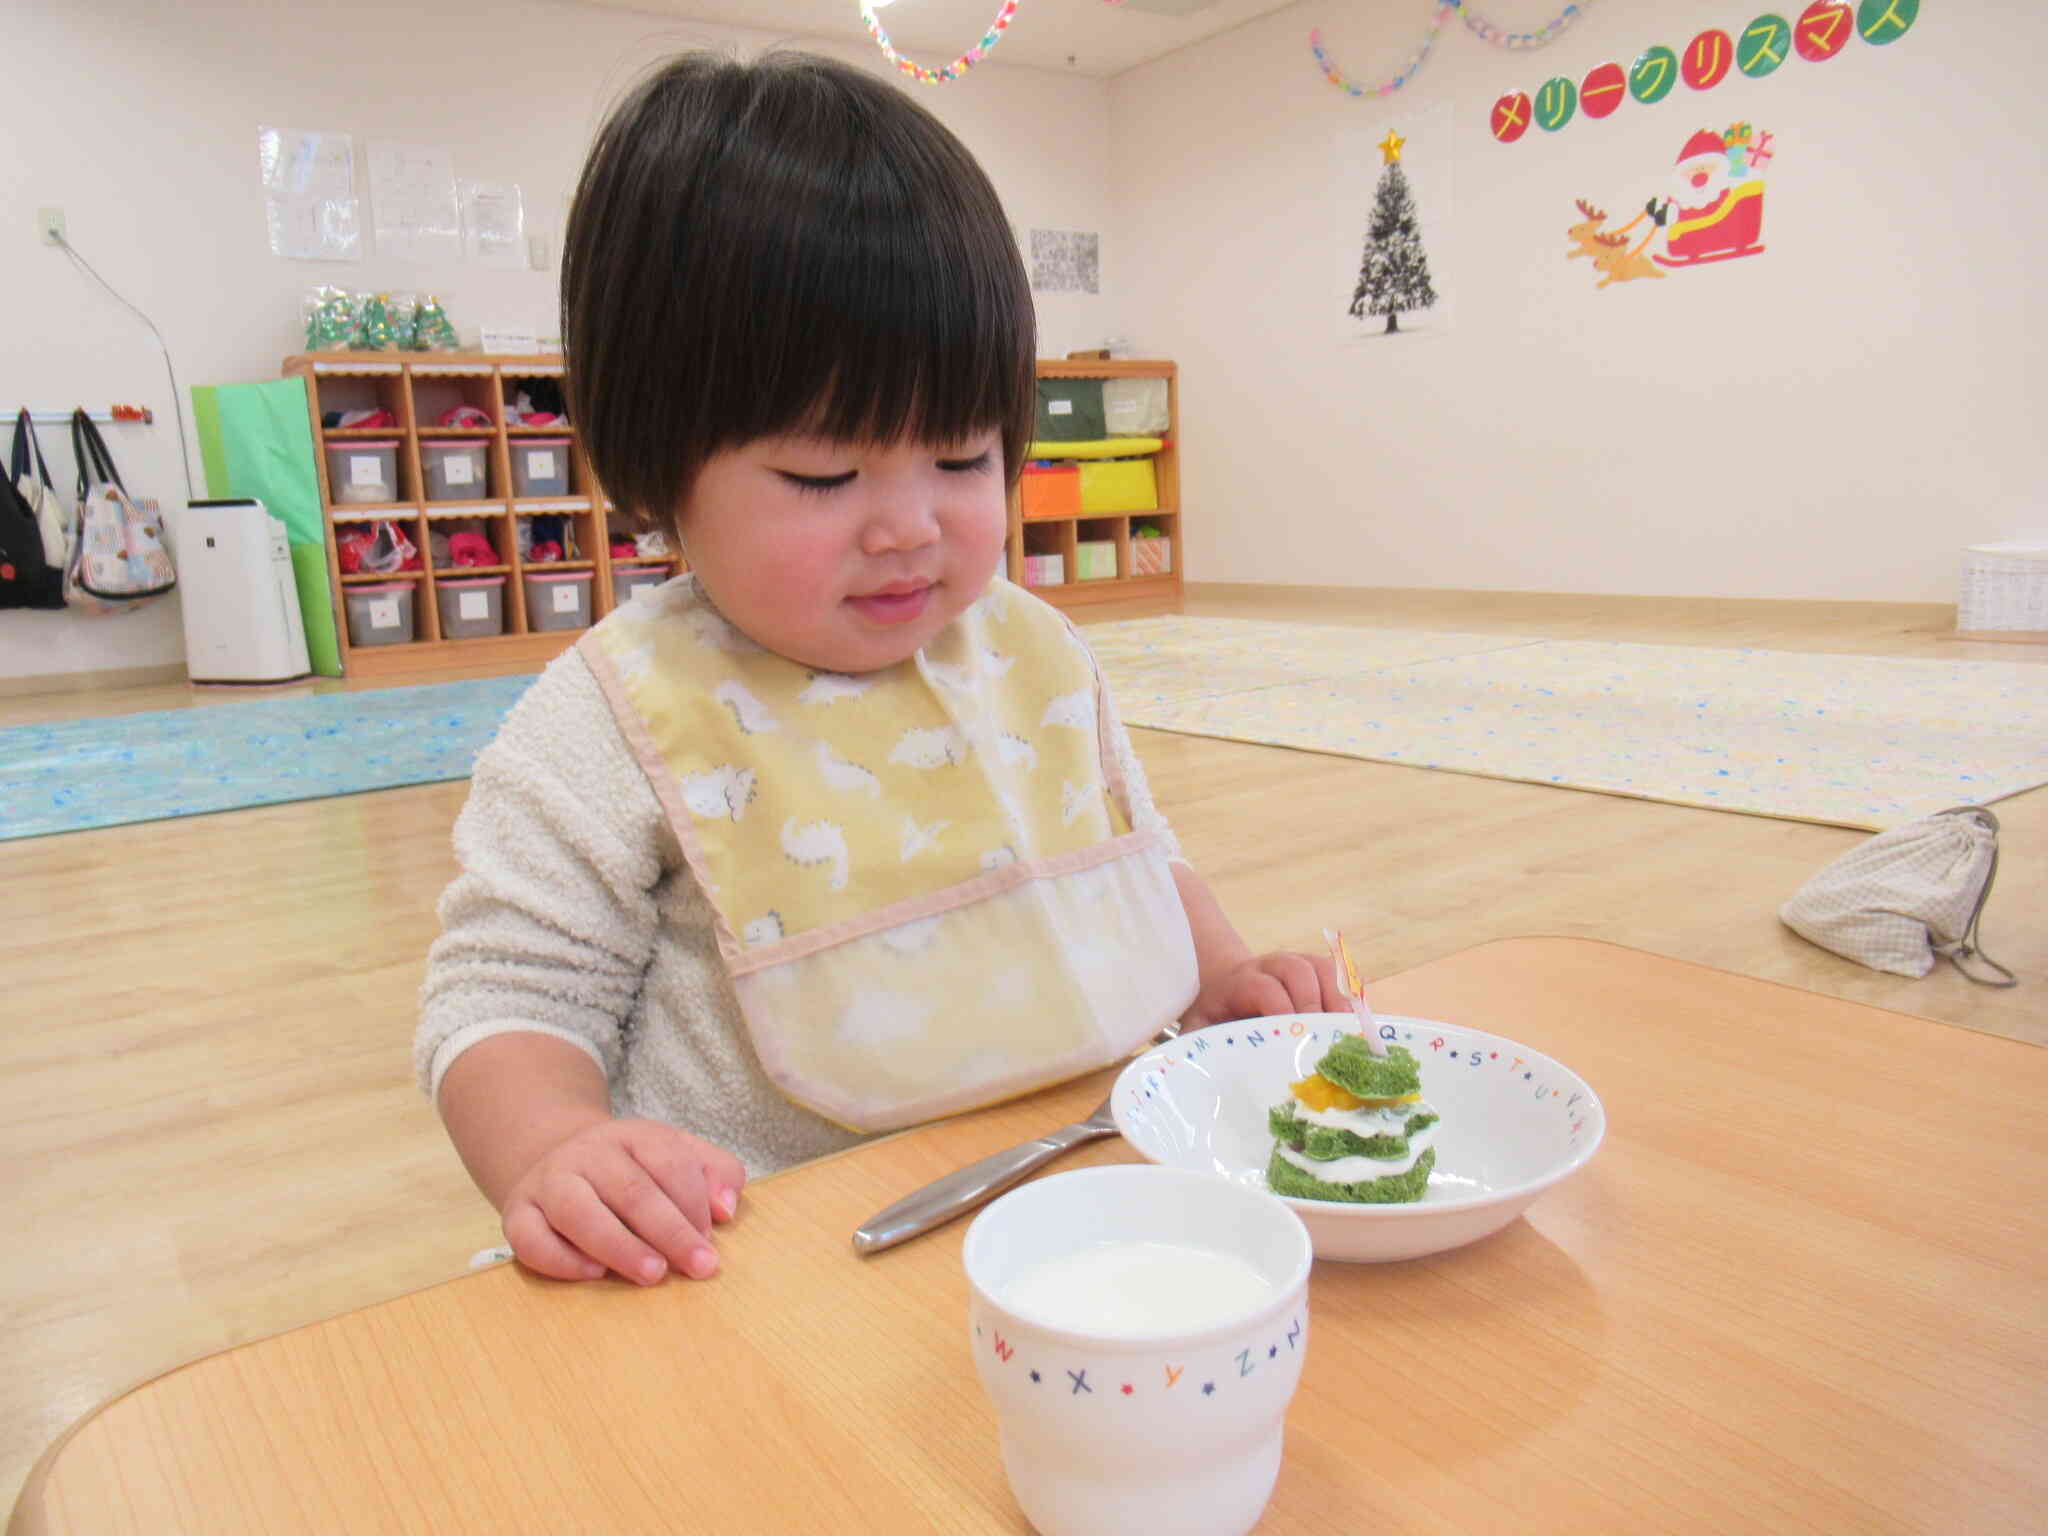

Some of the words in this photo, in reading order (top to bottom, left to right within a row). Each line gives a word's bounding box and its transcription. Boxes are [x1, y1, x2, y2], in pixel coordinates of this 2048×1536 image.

[1247, 1029, 1265, 1048] N
[1289, 1022, 1305, 1037] O
[1379, 1024, 1398, 1042] Q
[1469, 1051, 1482, 1067] S
[993, 1328, 1014, 1363] W
[1067, 1368, 1093, 1396] X
[1164, 1364, 1185, 1388] Y
[1233, 1347, 1255, 1378] Z
